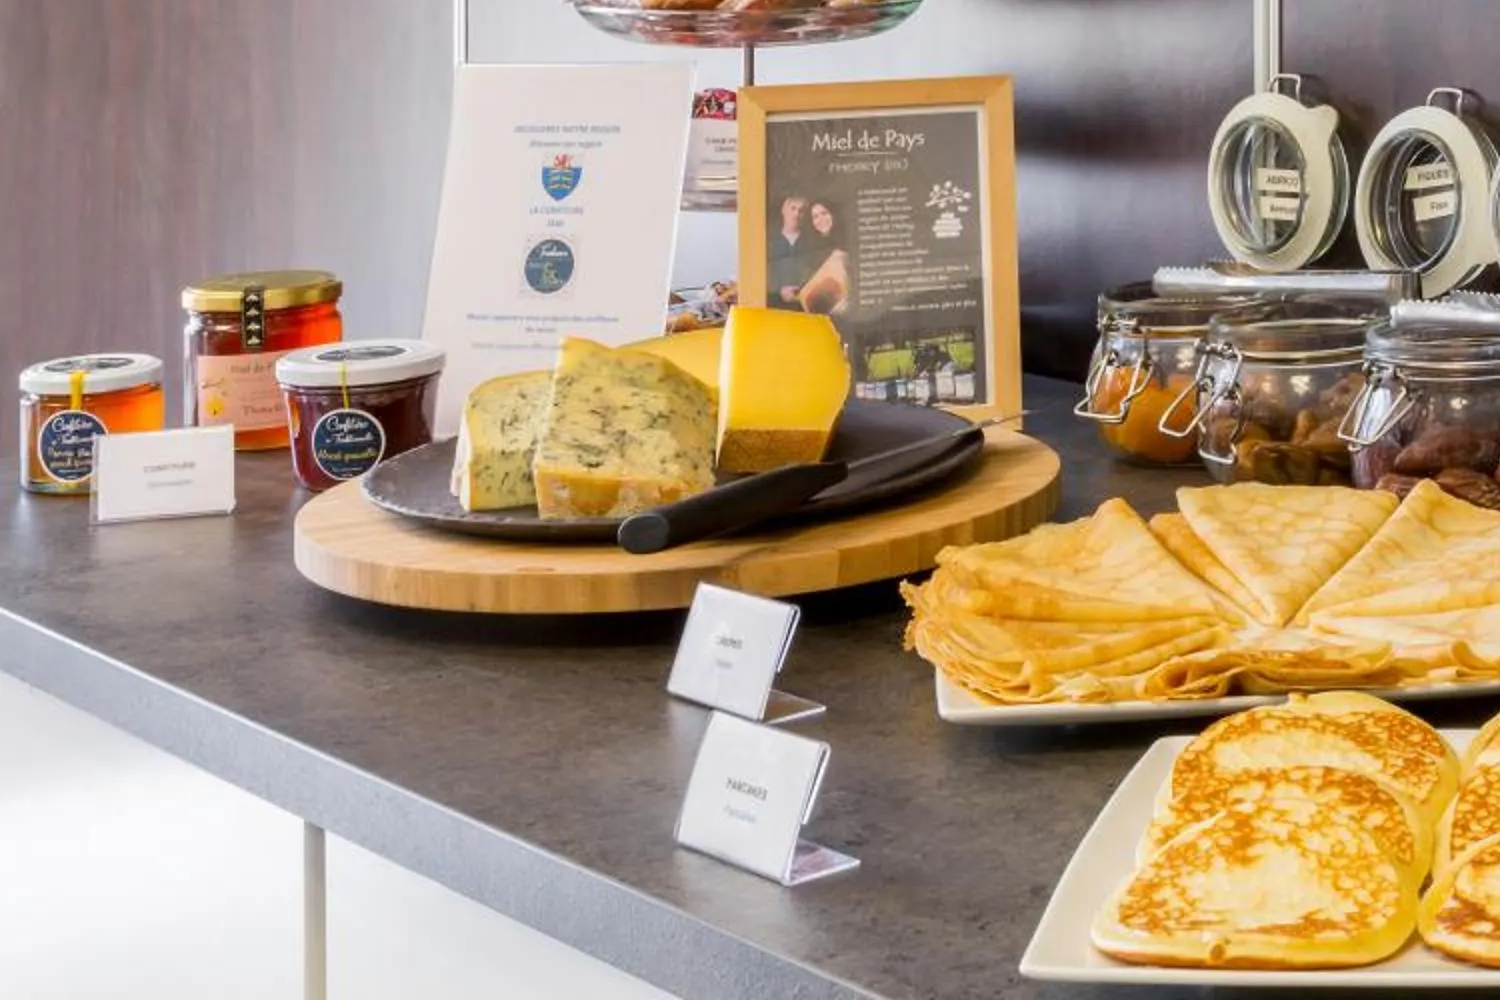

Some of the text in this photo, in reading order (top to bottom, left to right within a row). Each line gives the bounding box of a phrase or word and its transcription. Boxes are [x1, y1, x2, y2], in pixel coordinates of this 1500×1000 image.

[811, 128, 925, 153] Miel de Pays
